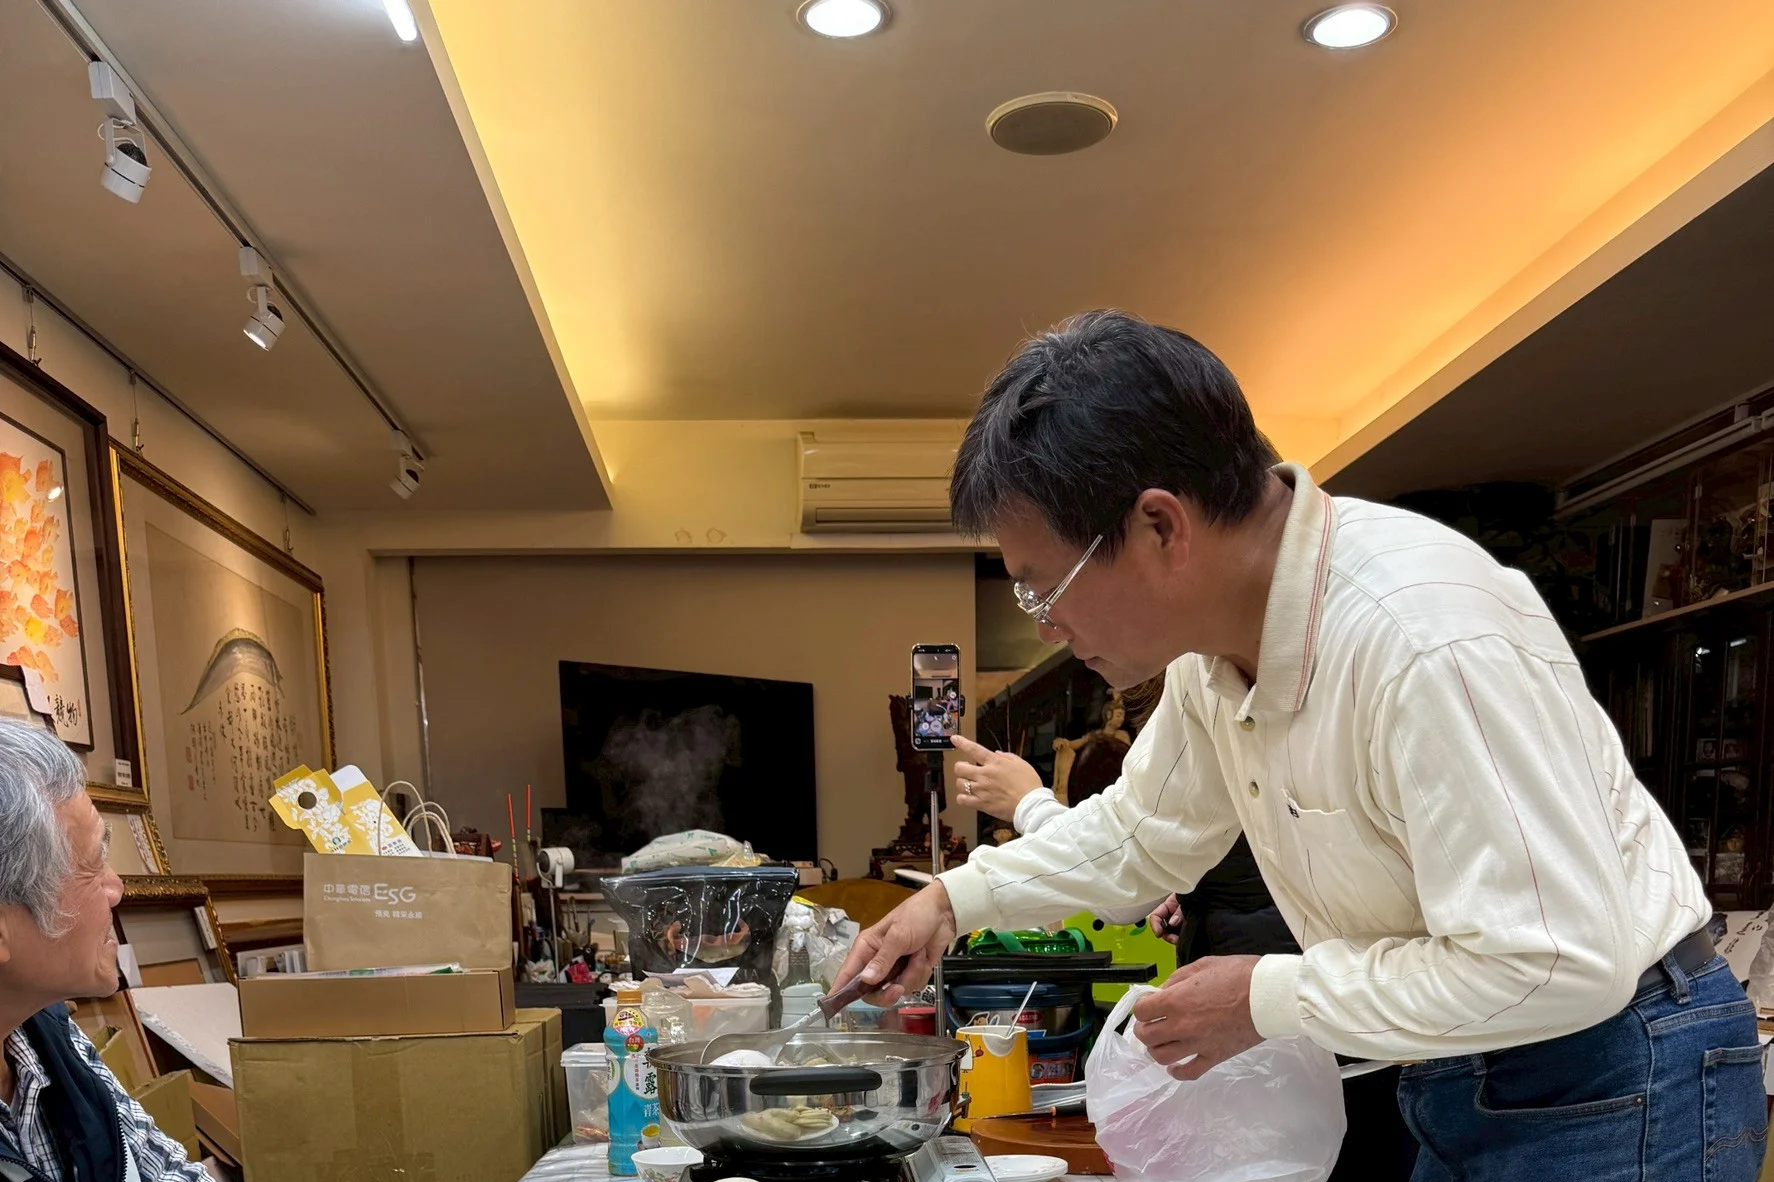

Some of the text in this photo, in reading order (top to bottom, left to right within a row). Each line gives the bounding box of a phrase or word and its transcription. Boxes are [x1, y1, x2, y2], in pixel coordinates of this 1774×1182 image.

[323, 883, 416, 905] 中華電信 ESG
